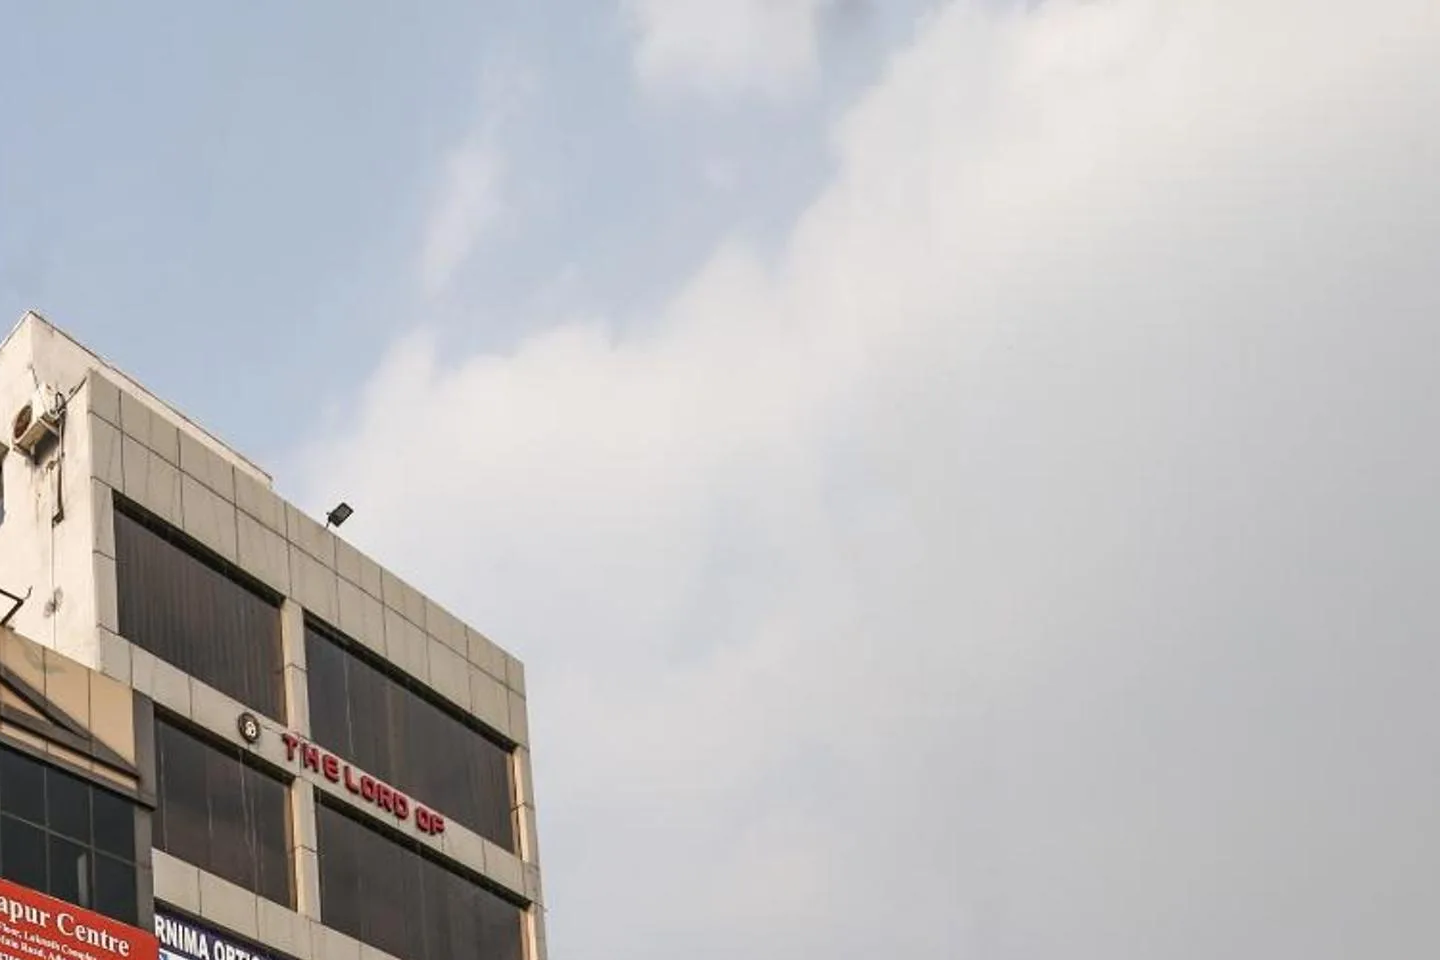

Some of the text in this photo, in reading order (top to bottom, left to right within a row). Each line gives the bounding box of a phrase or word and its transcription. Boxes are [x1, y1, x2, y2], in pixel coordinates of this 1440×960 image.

[281, 733, 445, 835] THE LORD OF
[57, 913, 130, 957] Centre
